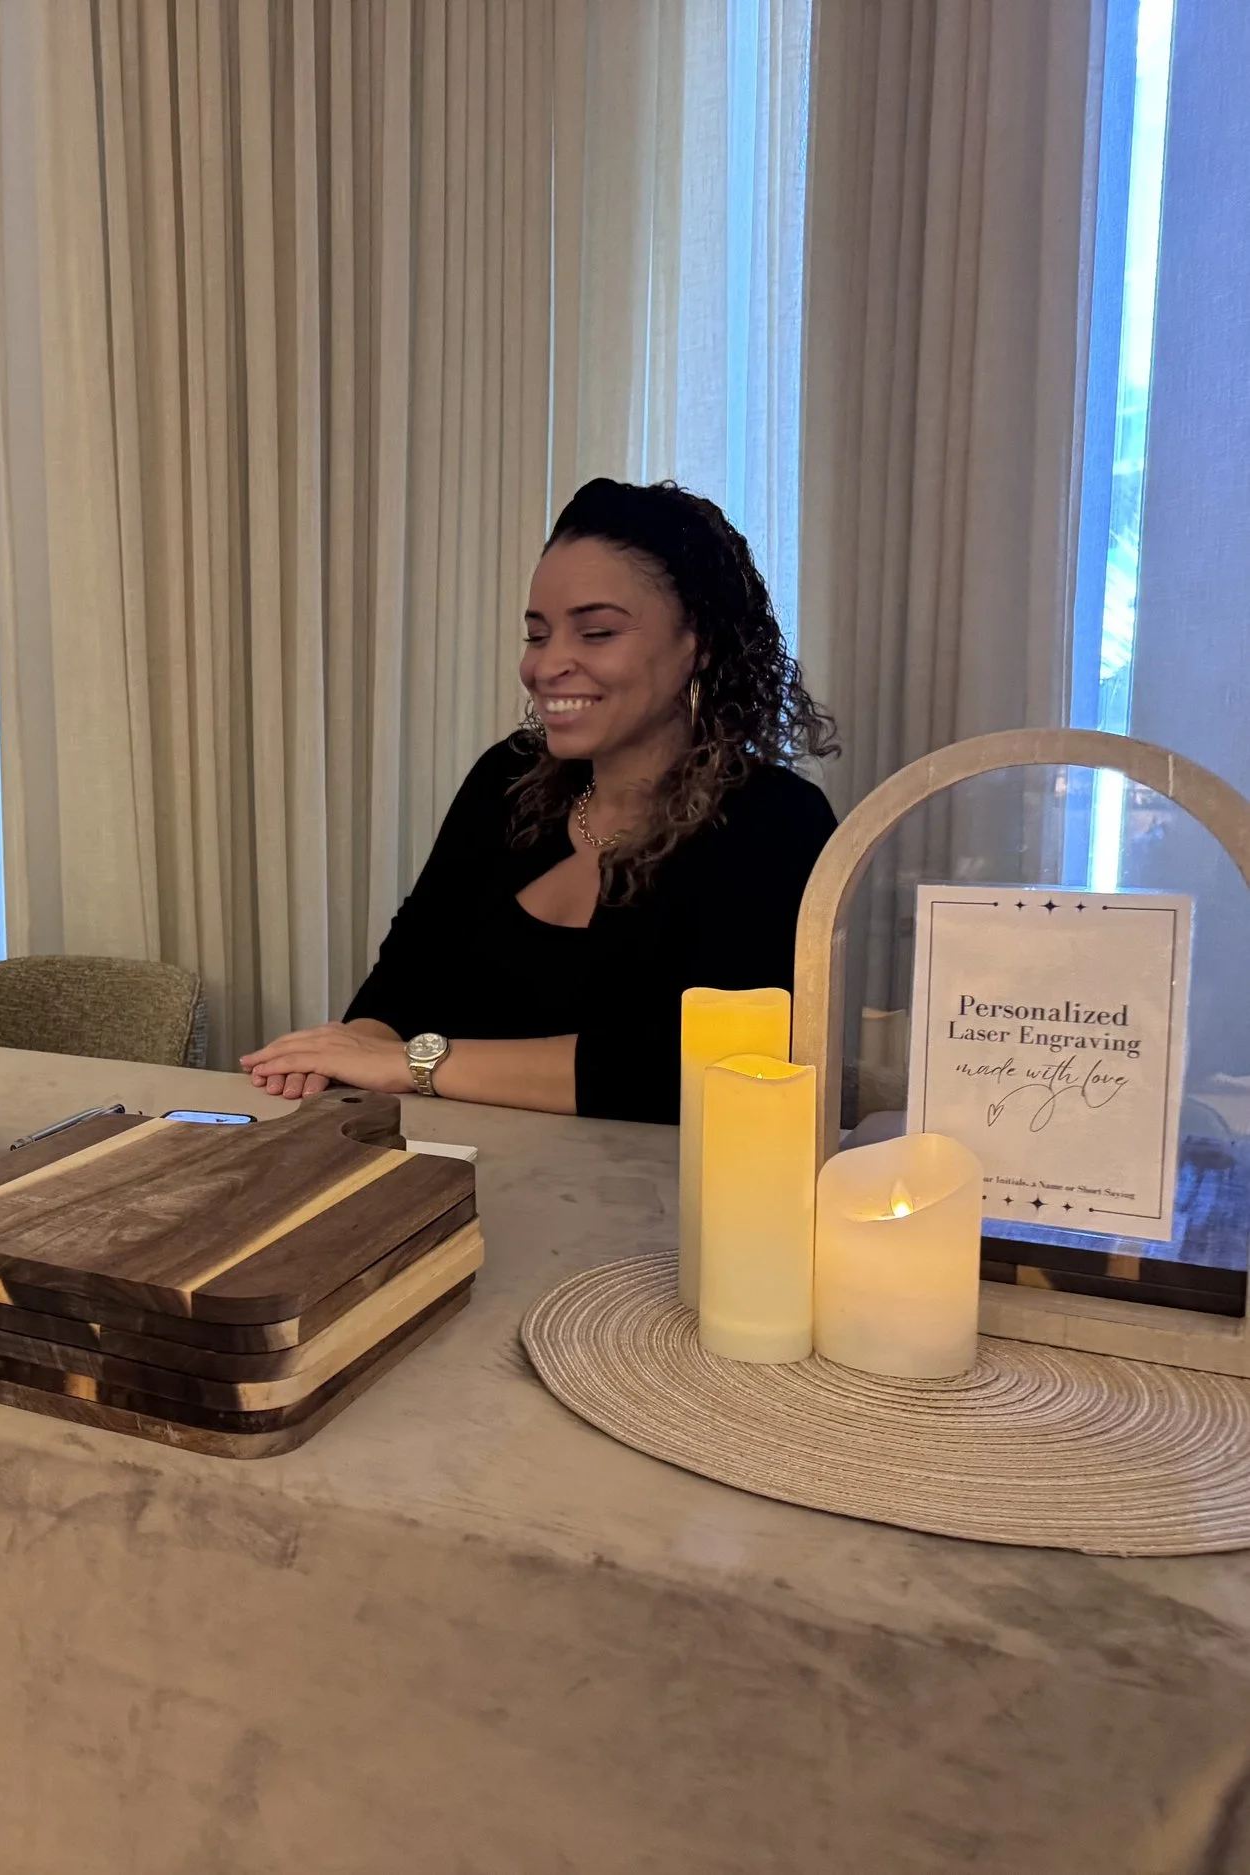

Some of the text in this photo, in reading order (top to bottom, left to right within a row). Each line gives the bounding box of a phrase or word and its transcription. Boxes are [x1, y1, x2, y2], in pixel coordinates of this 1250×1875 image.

[957, 994, 1130, 1027] Personalized
[946, 1021, 1142, 1058] Laser Engraving
[956, 1055, 1130, 1107] made with love
